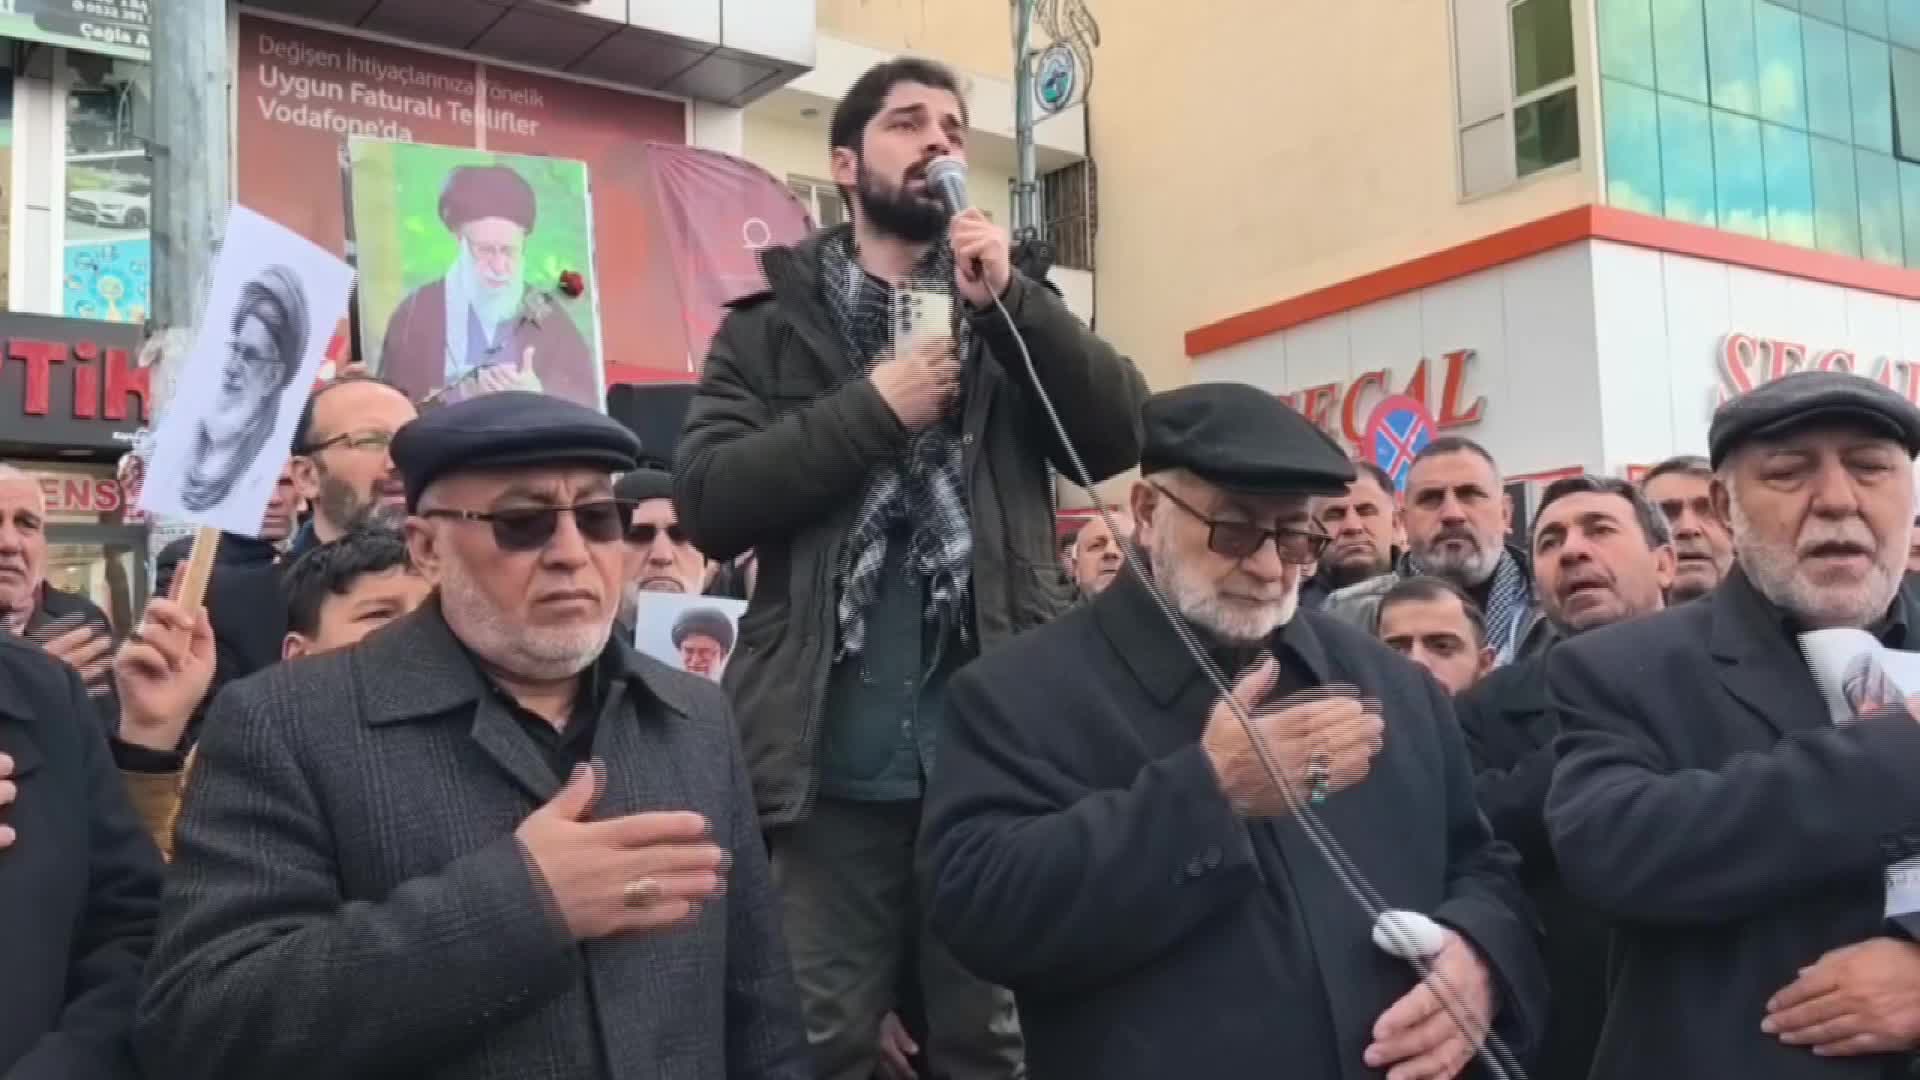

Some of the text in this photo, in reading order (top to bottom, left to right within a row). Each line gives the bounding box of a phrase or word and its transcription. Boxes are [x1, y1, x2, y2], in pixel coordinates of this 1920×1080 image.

[258, 63, 343, 99] Uygun
[350, 82, 442, 121] Faturalı
[259, 33, 342, 67] Değişen
[484, 78, 545, 109] önelik
[257, 95, 413, 143] Vodafone'da
